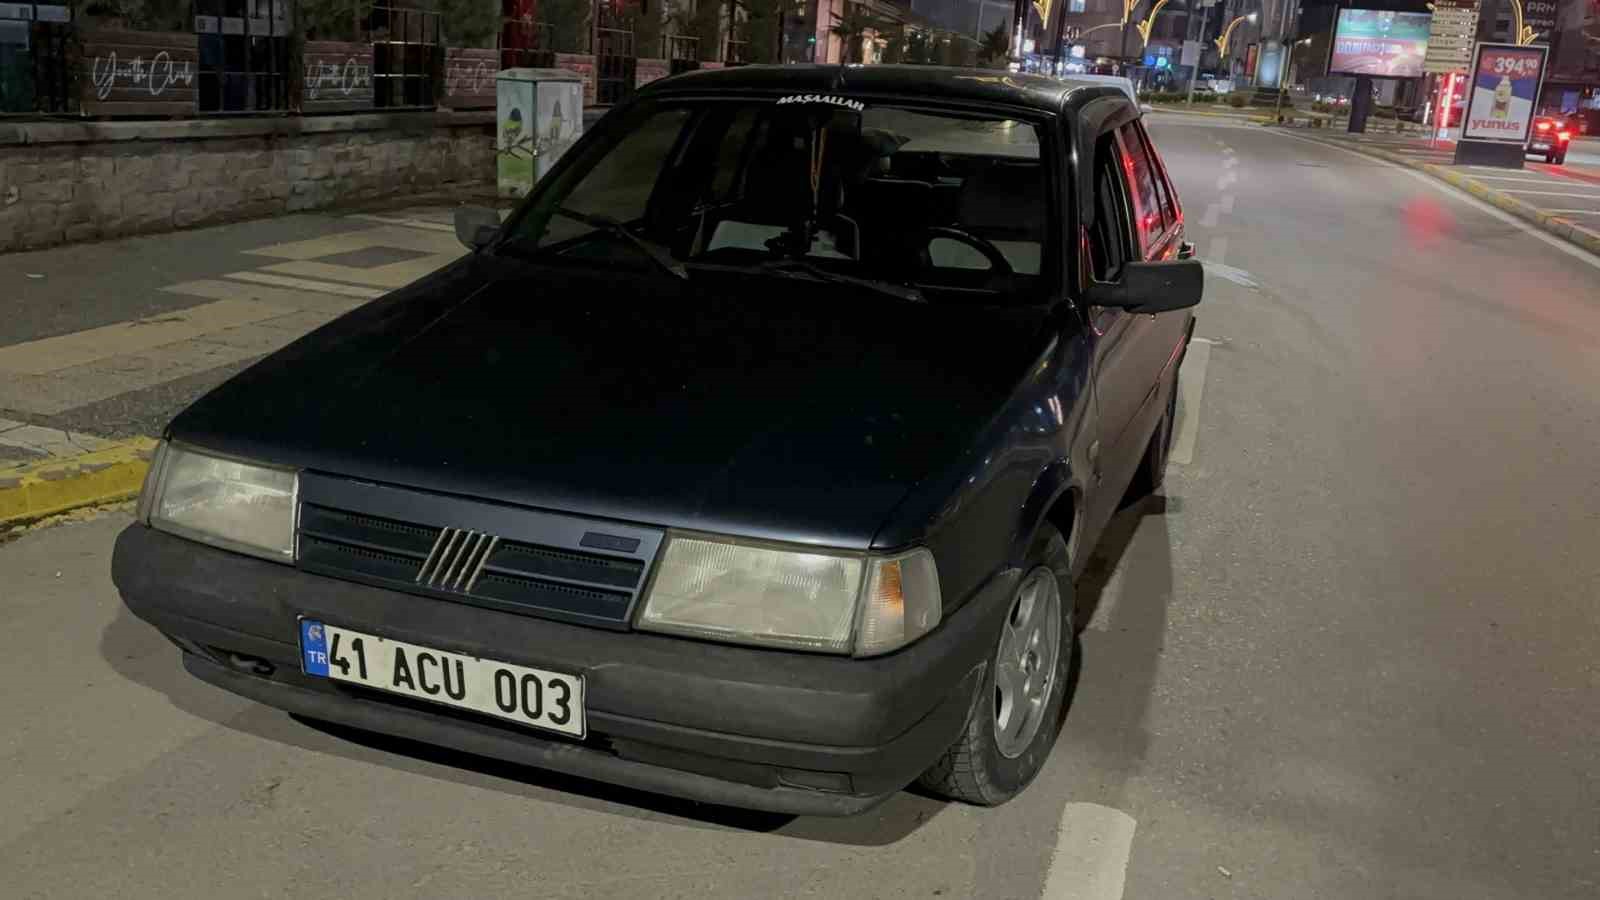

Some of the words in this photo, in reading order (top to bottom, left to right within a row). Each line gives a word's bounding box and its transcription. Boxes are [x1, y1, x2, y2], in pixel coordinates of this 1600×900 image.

[1471, 119, 1521, 131] yunus
[307, 650, 327, 665] TR
[329, 633, 368, 680] 41
[392, 647, 466, 701] ACU
[494, 668, 572, 726] 003
